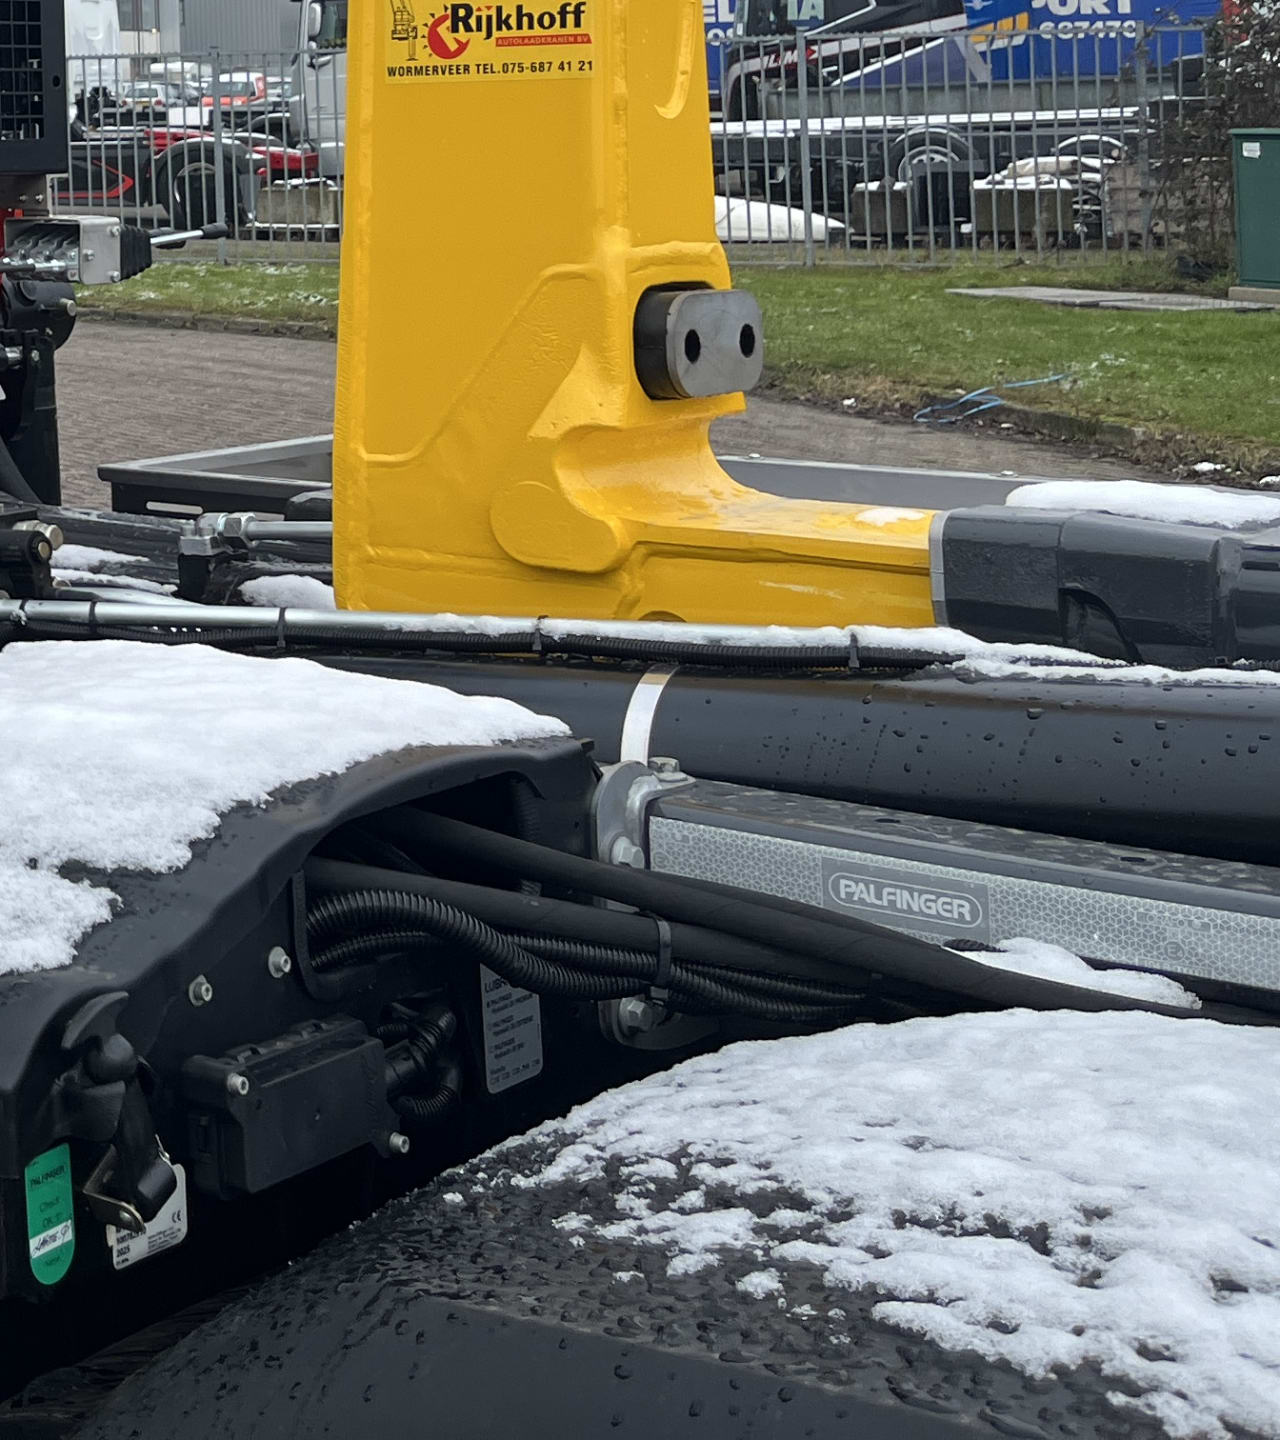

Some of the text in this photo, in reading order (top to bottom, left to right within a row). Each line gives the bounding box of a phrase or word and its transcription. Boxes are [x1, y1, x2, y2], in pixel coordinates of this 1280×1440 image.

[450, 1, 587, 41] Rijkhoff
[387, 64, 470, 77] WORMERVEER
[558, 61, 572, 72] 41
[578, 60, 593, 71] 21
[839, 878, 971, 921] PALFINGER
